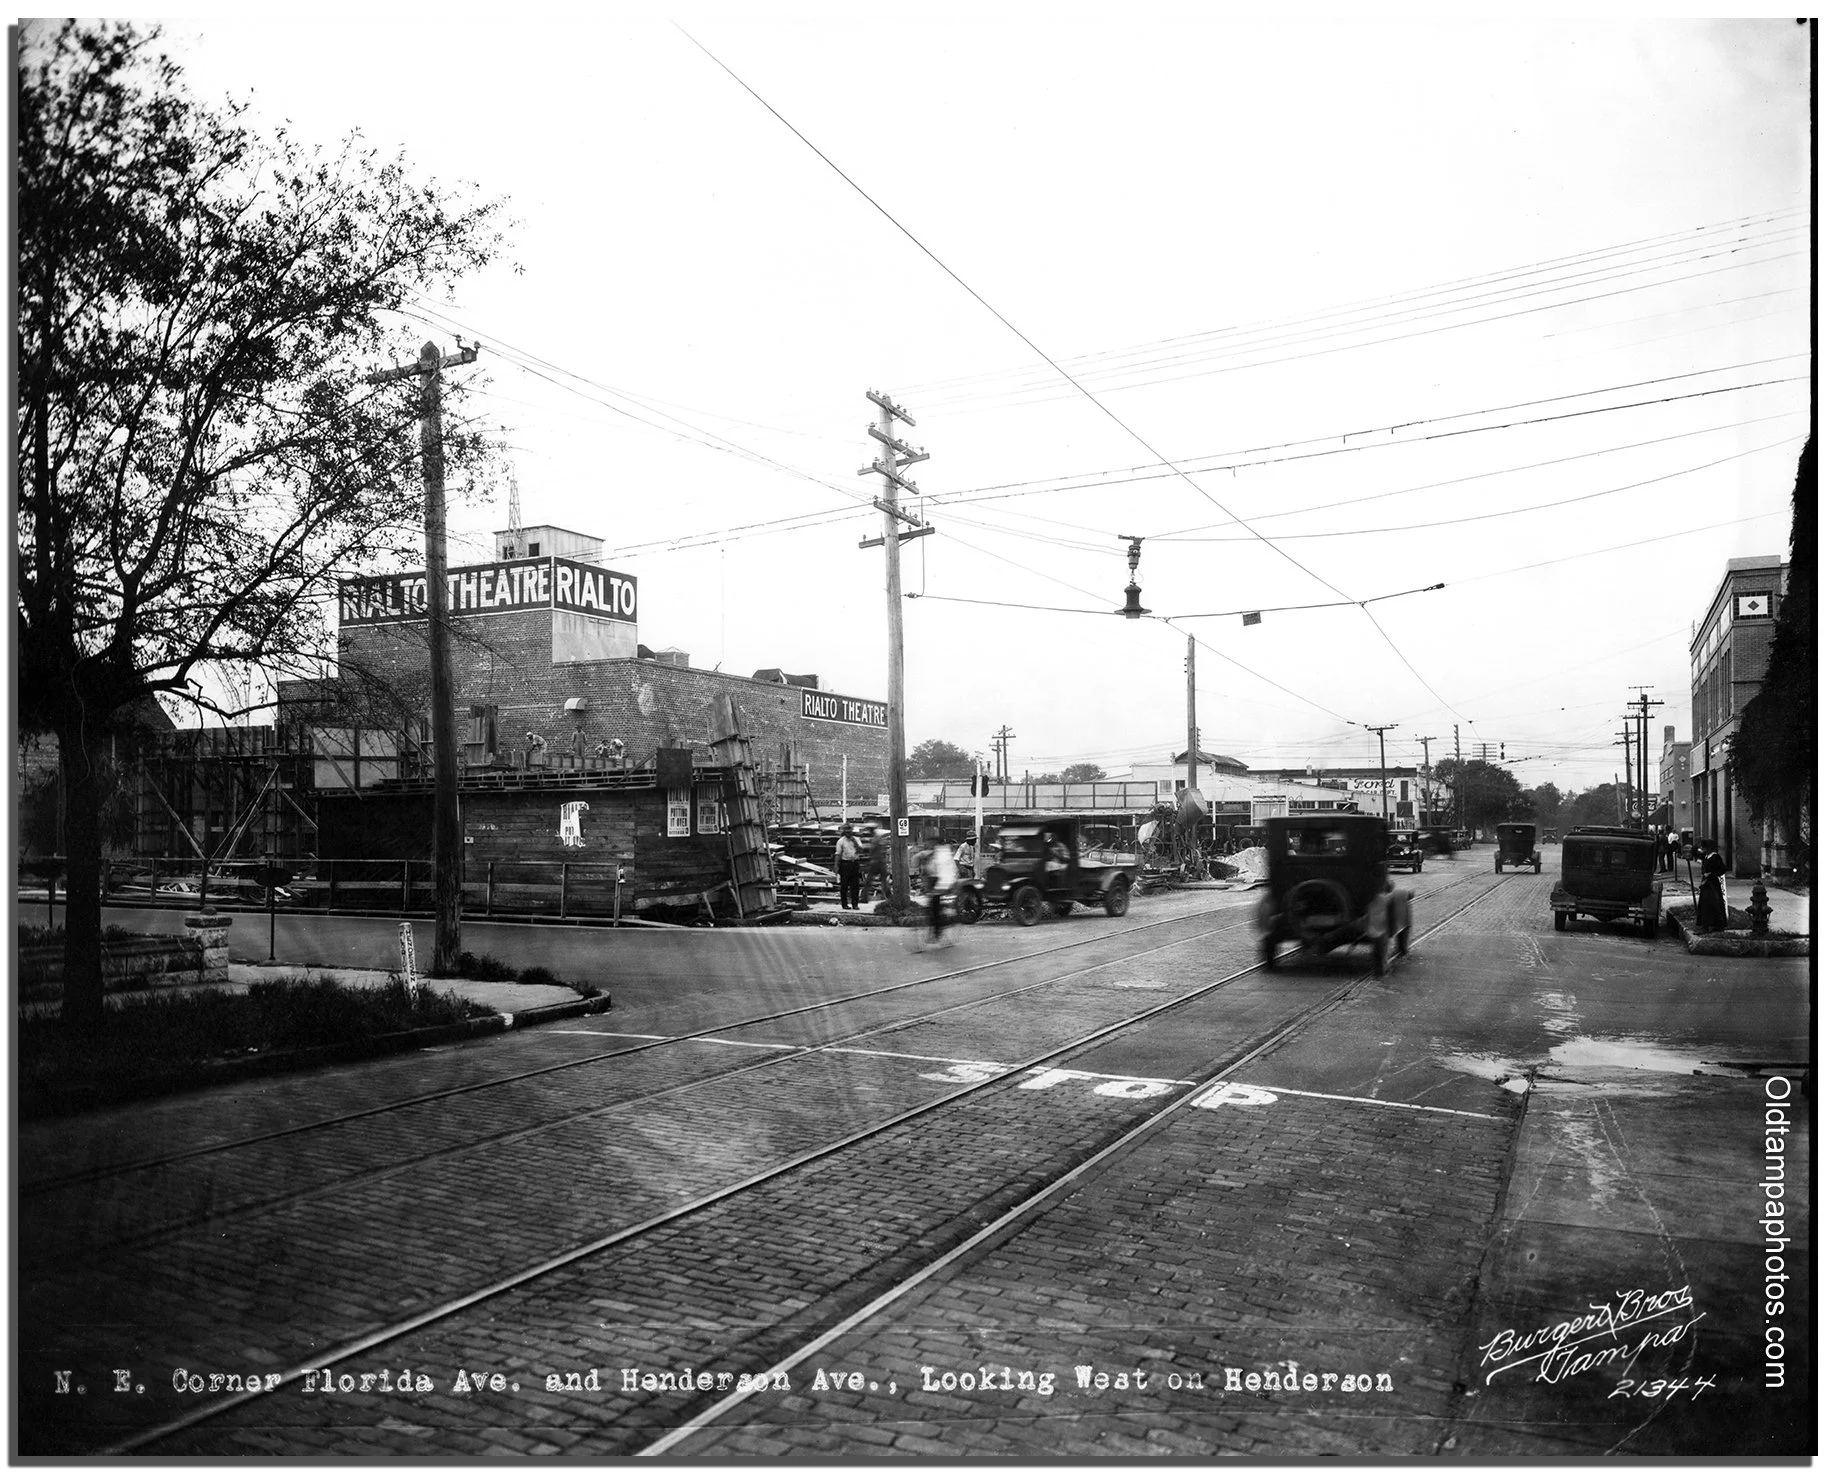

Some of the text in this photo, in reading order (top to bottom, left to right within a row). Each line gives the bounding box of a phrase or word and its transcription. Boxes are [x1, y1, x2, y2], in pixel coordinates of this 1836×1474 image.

[341, 564, 550, 621] RIALTO THEATRE
[556, 564, 636, 616] RIALTO
[805, 694, 885, 725] RIALTO THEATRE
[1353, 777, 1395, 789] Ford
[919, 1061, 1279, 1109] STOP
